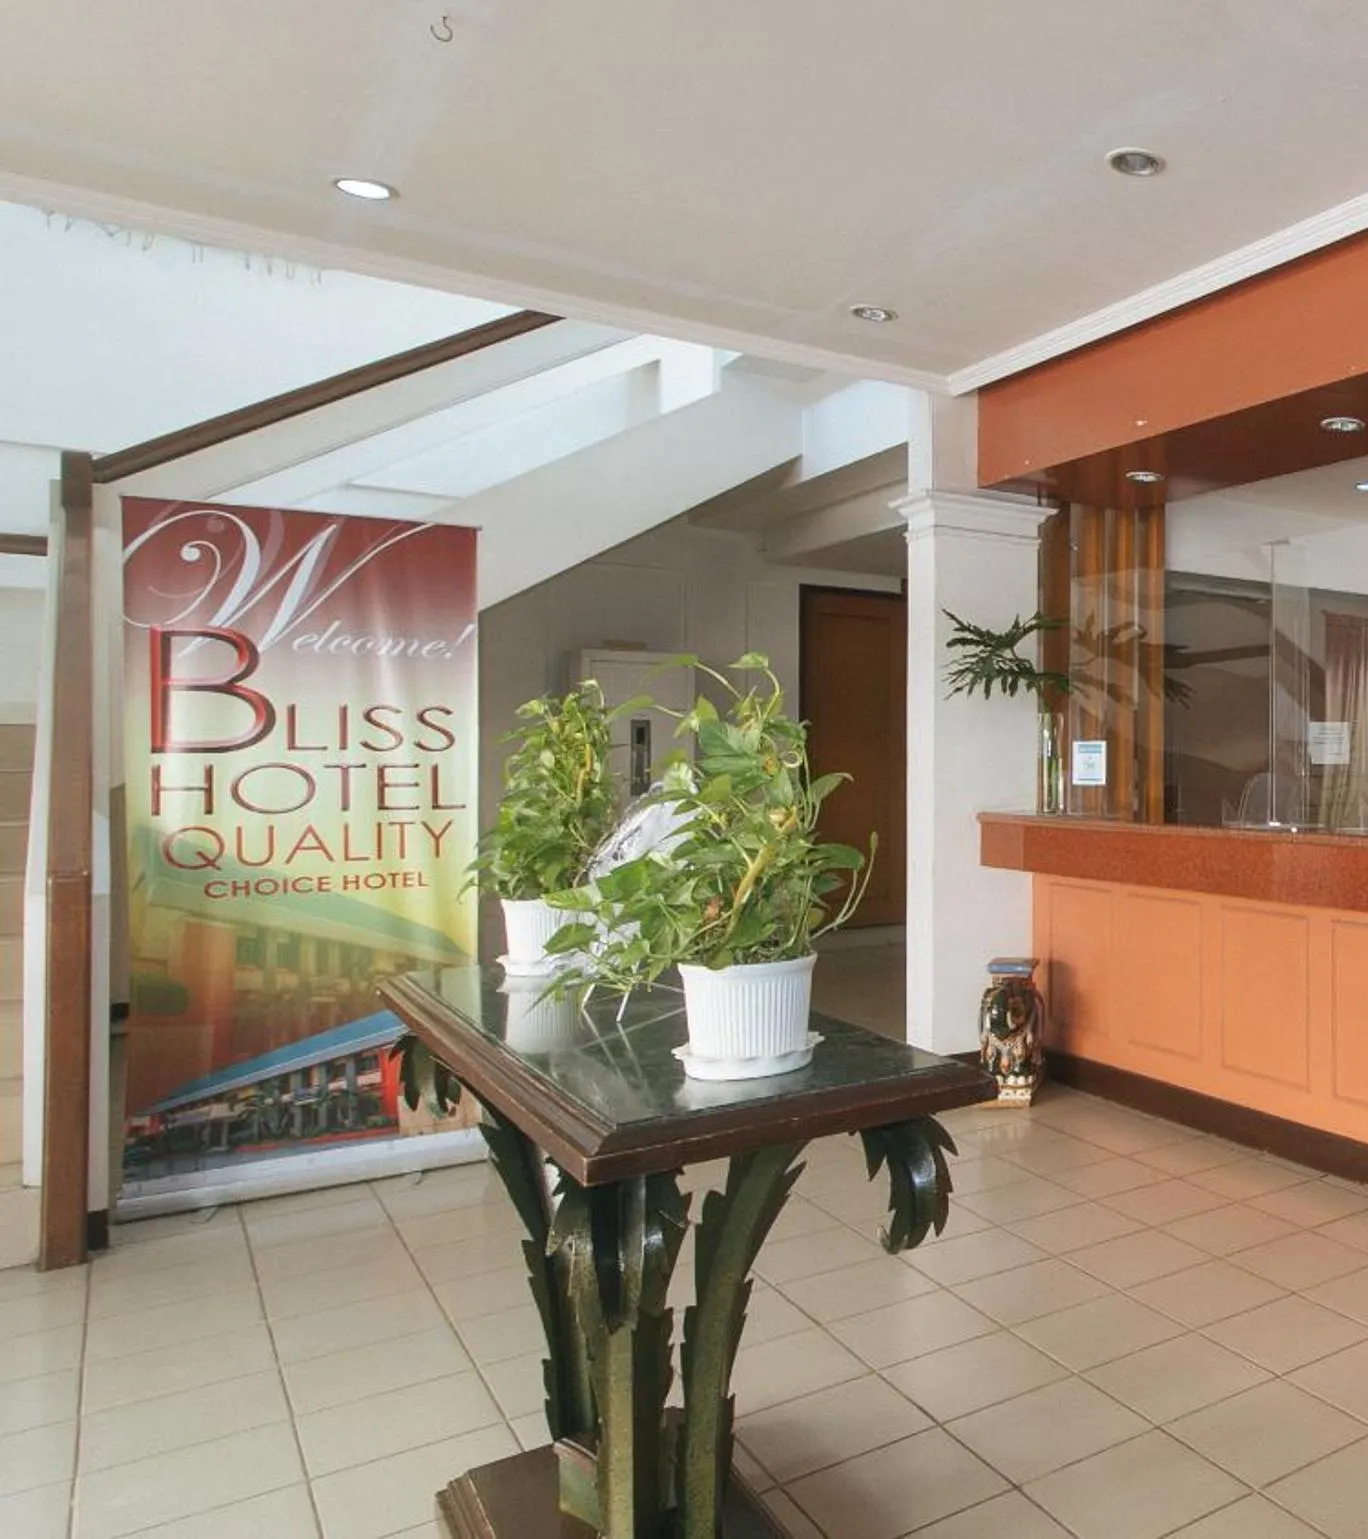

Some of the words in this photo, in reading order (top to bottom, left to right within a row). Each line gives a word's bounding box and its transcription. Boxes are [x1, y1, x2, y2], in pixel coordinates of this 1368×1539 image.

[150, 762, 467, 816] HOTEL
[163, 820, 454, 871] QUALITY
[204, 876, 332, 900] CHOICE
[342, 871, 430, 892] HOTEL
